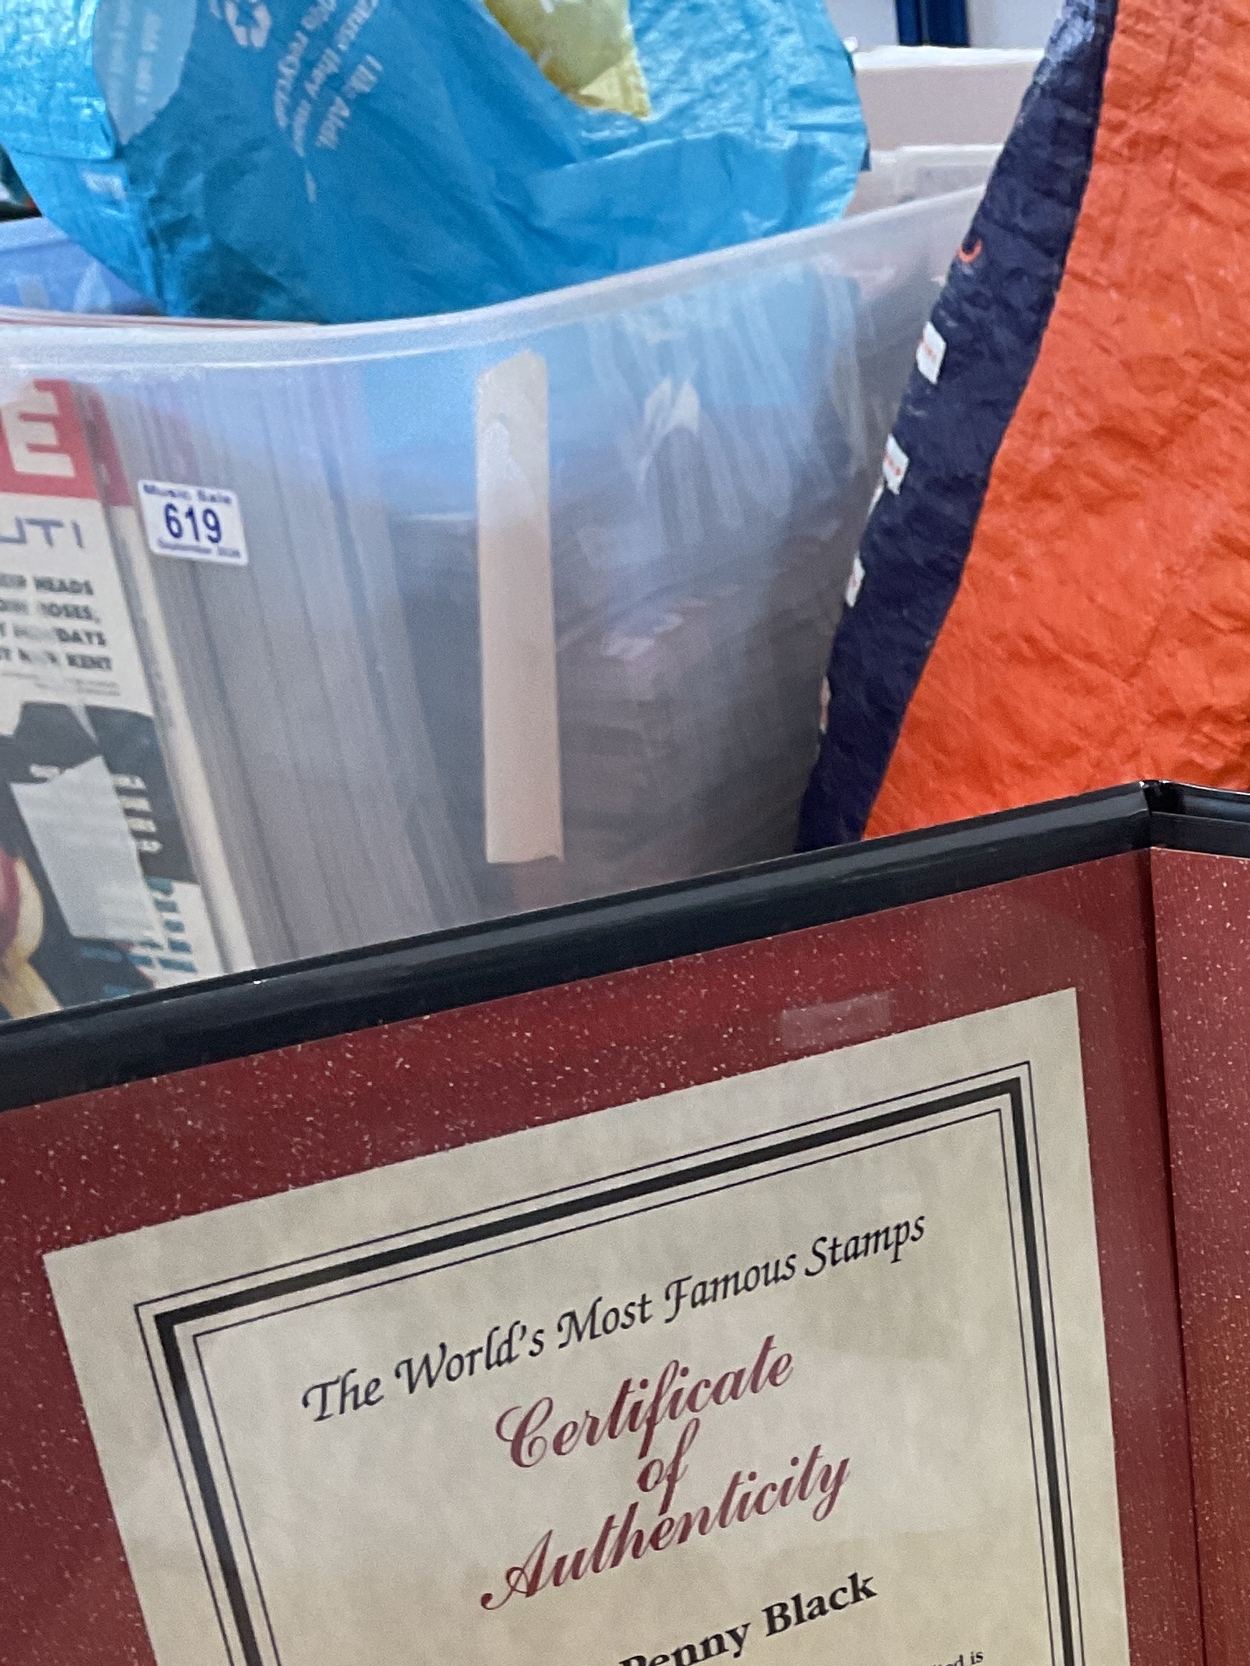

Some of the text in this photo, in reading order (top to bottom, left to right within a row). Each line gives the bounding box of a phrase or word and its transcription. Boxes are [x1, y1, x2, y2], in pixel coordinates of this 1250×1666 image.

[164, 501, 222, 544] 619
[301, 1215, 925, 1422] The World's Most Famous Stamps
[494, 1333, 794, 1469] Certificate
[635, 1416, 701, 1517] of
[478, 1443, 851, 1611] Authenticity
[760, 1571, 878, 1637] Black
[970, 1650, 984, 1665] is
